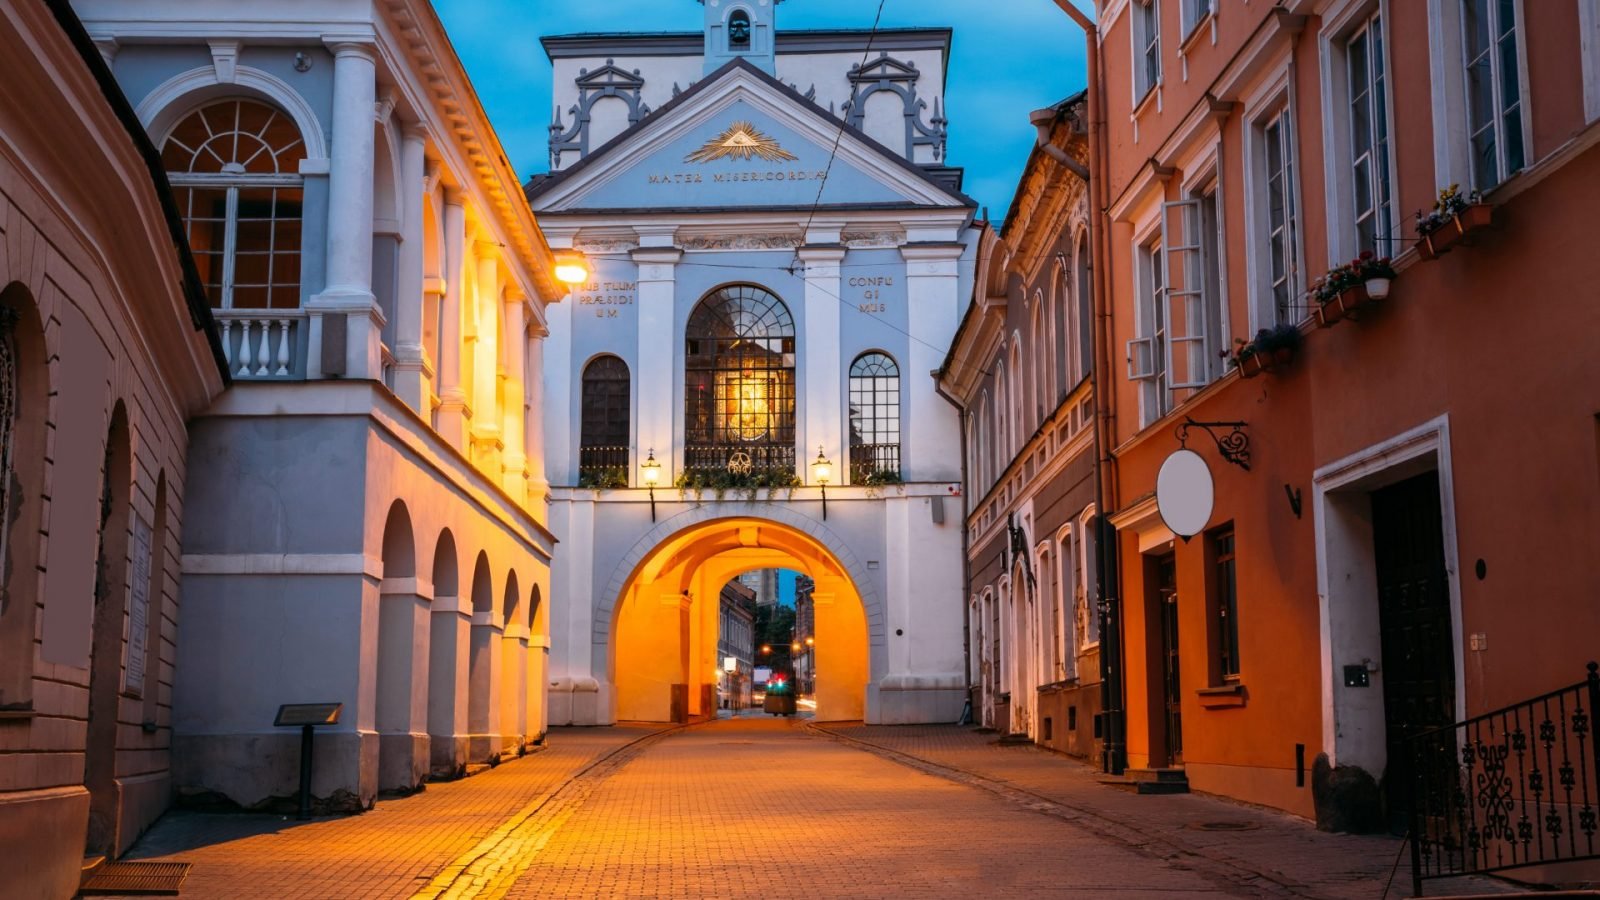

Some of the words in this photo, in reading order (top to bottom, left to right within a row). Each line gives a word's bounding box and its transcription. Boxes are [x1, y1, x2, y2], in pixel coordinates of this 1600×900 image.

[648, 173, 702, 184] MATER
[848, 277, 893, 287] CONFU
[859, 303, 886, 313] MUS
